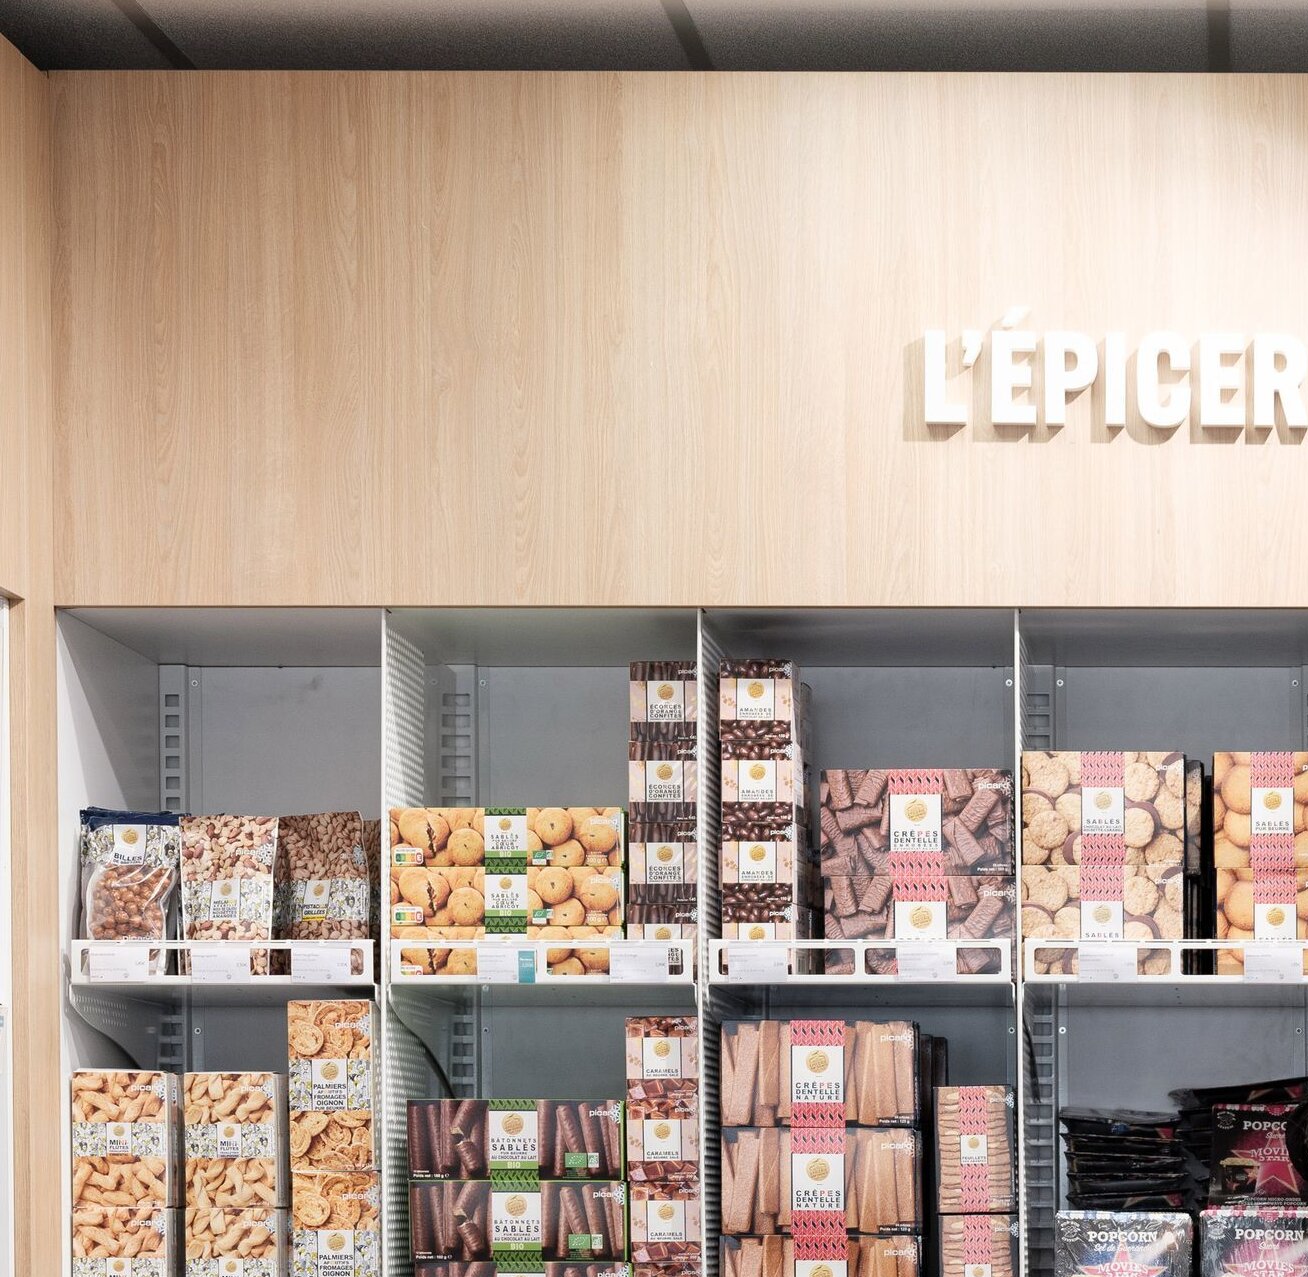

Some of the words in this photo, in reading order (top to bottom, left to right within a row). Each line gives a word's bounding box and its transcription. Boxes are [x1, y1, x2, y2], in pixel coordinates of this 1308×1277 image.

[893, 830, 938, 838] CRÊPES
[114, 852, 142, 862] BILLES
[796, 1081, 840, 1089] CRÊPES
[1243, 1120, 1287, 1131] POPCO
[492, 1142, 536, 1152] SABLÉS
[796, 1188, 841, 1196] CRÊPES
[495, 1224, 540, 1233] SABLÉS
[1088, 1231, 1157, 1243] POPCORN
[1235, 1228, 1304, 1240] POPCORN
[1098, 1262, 1149, 1275] MOVIES
[1245, 1261, 1294, 1273] MOVIES
